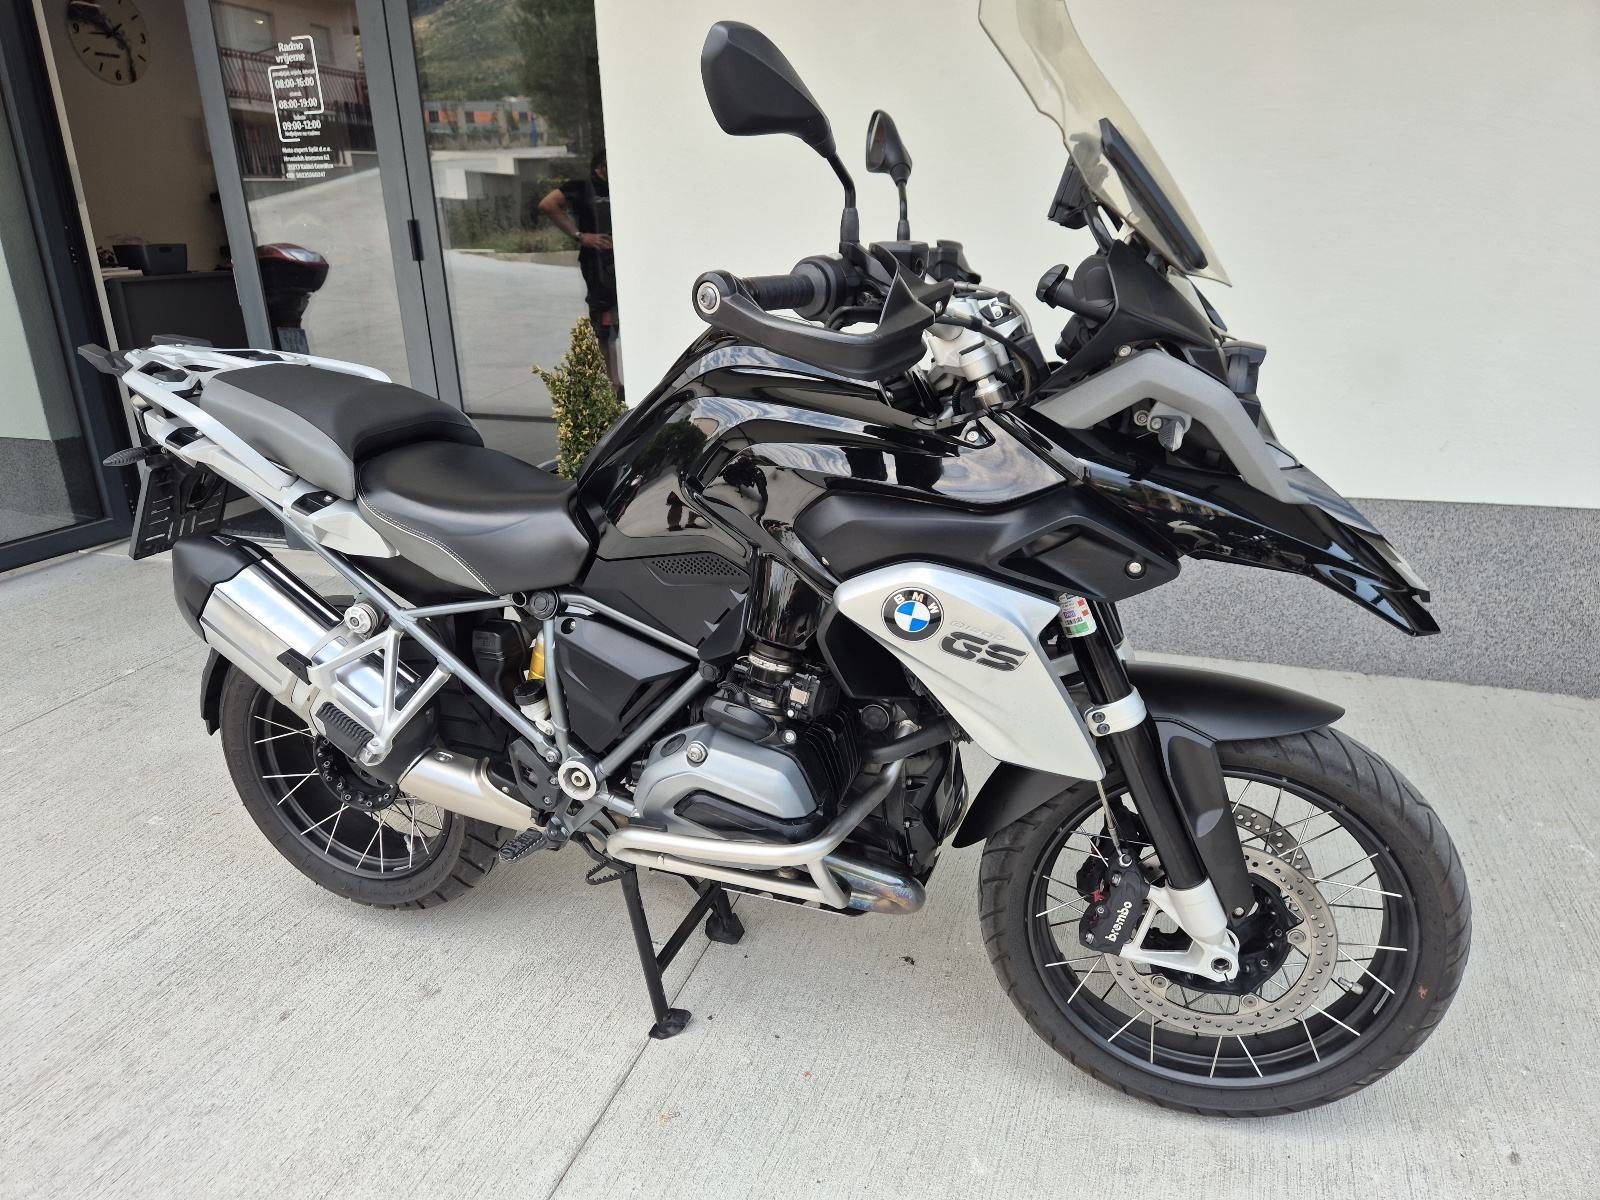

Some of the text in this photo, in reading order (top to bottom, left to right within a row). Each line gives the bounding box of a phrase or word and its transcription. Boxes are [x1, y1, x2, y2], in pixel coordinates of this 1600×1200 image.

[278, 41, 303, 52] Radno
[275, 53, 305, 65] vrijeme
[278, 97, 317, 109] 08:00-19:00
[282, 119, 321, 131] 09:00-12:00
[894, 592, 940, 614] BMW
[941, 632, 1026, 671] GS
[1105, 901, 1133, 942] brembo
